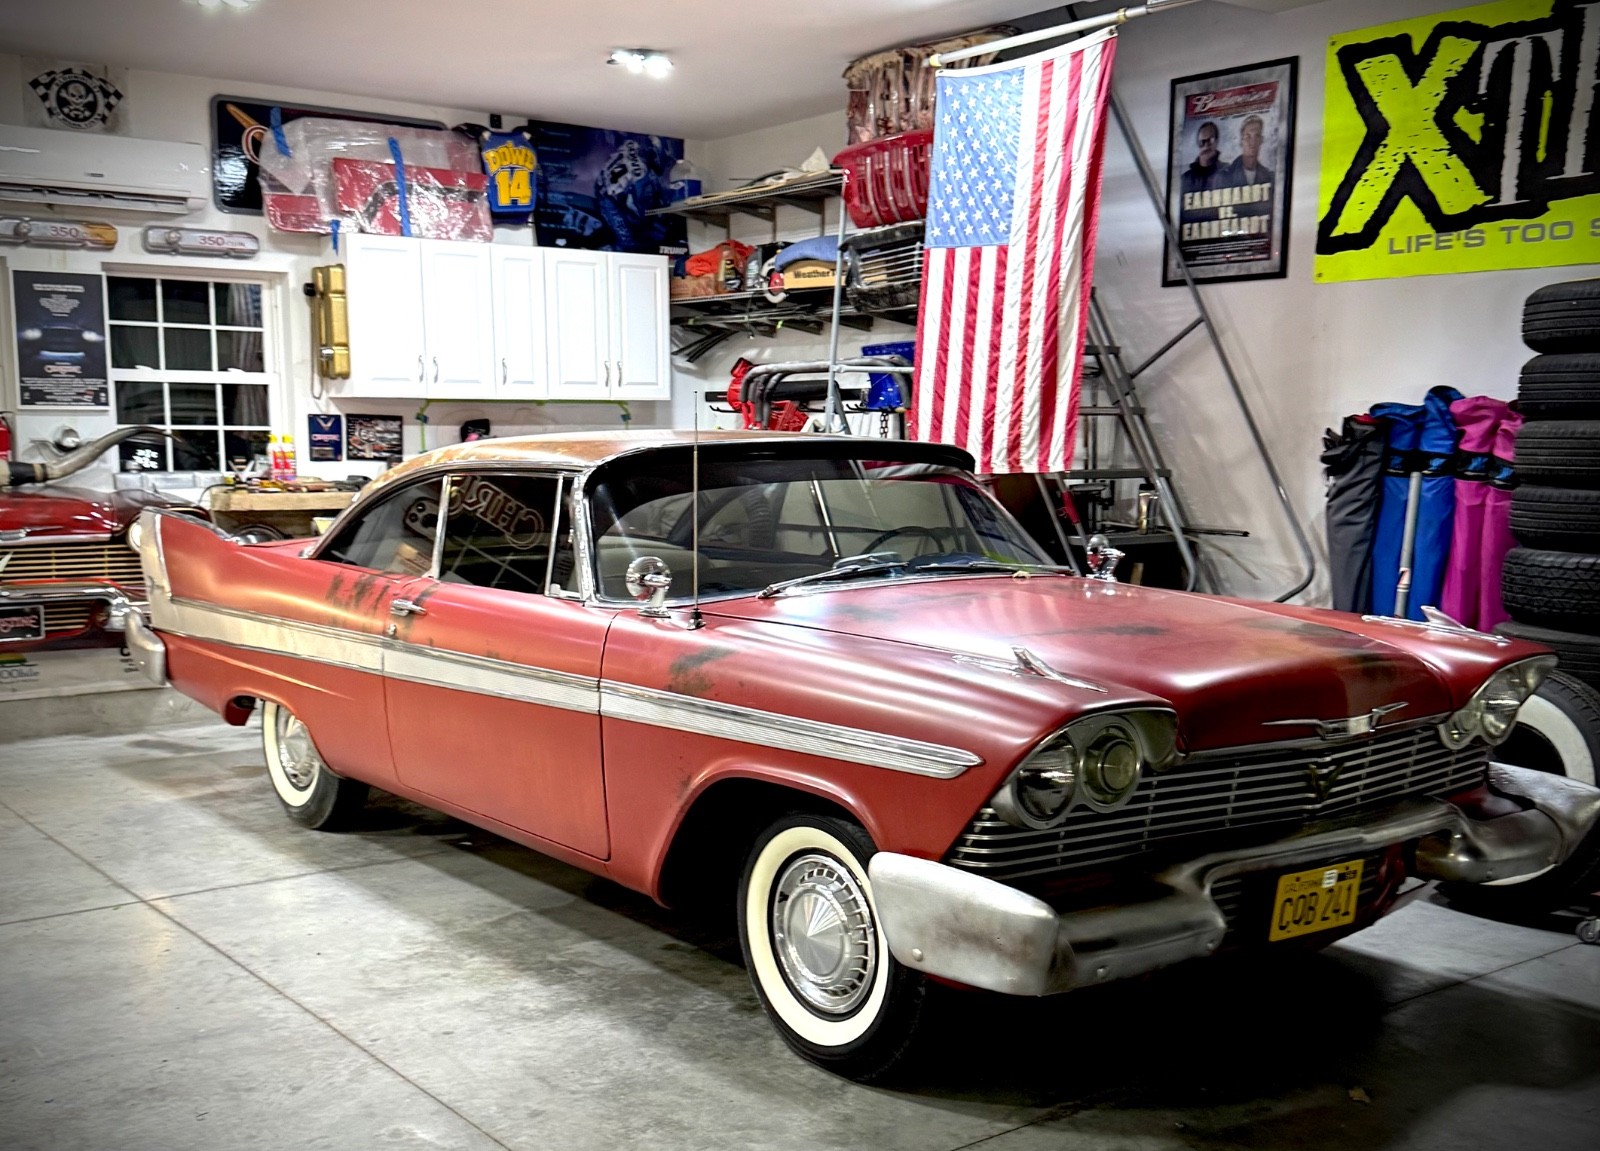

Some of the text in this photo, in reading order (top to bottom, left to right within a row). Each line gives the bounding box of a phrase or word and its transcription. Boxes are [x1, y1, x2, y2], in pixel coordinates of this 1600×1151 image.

[495, 169, 532, 206] 14
[1184, 183, 1271, 210] EARNHARDT
[50, 226, 79, 238] 350
[199, 235, 225, 246] 350
[1182, 215, 1270, 241] EARNHARDT
[1388, 229, 1486, 255] LIFE'S
[1501, 220, 1574, 244] TOO
[658, 245, 689, 255] TRUMP
[1320, 883, 1351, 921] 241
